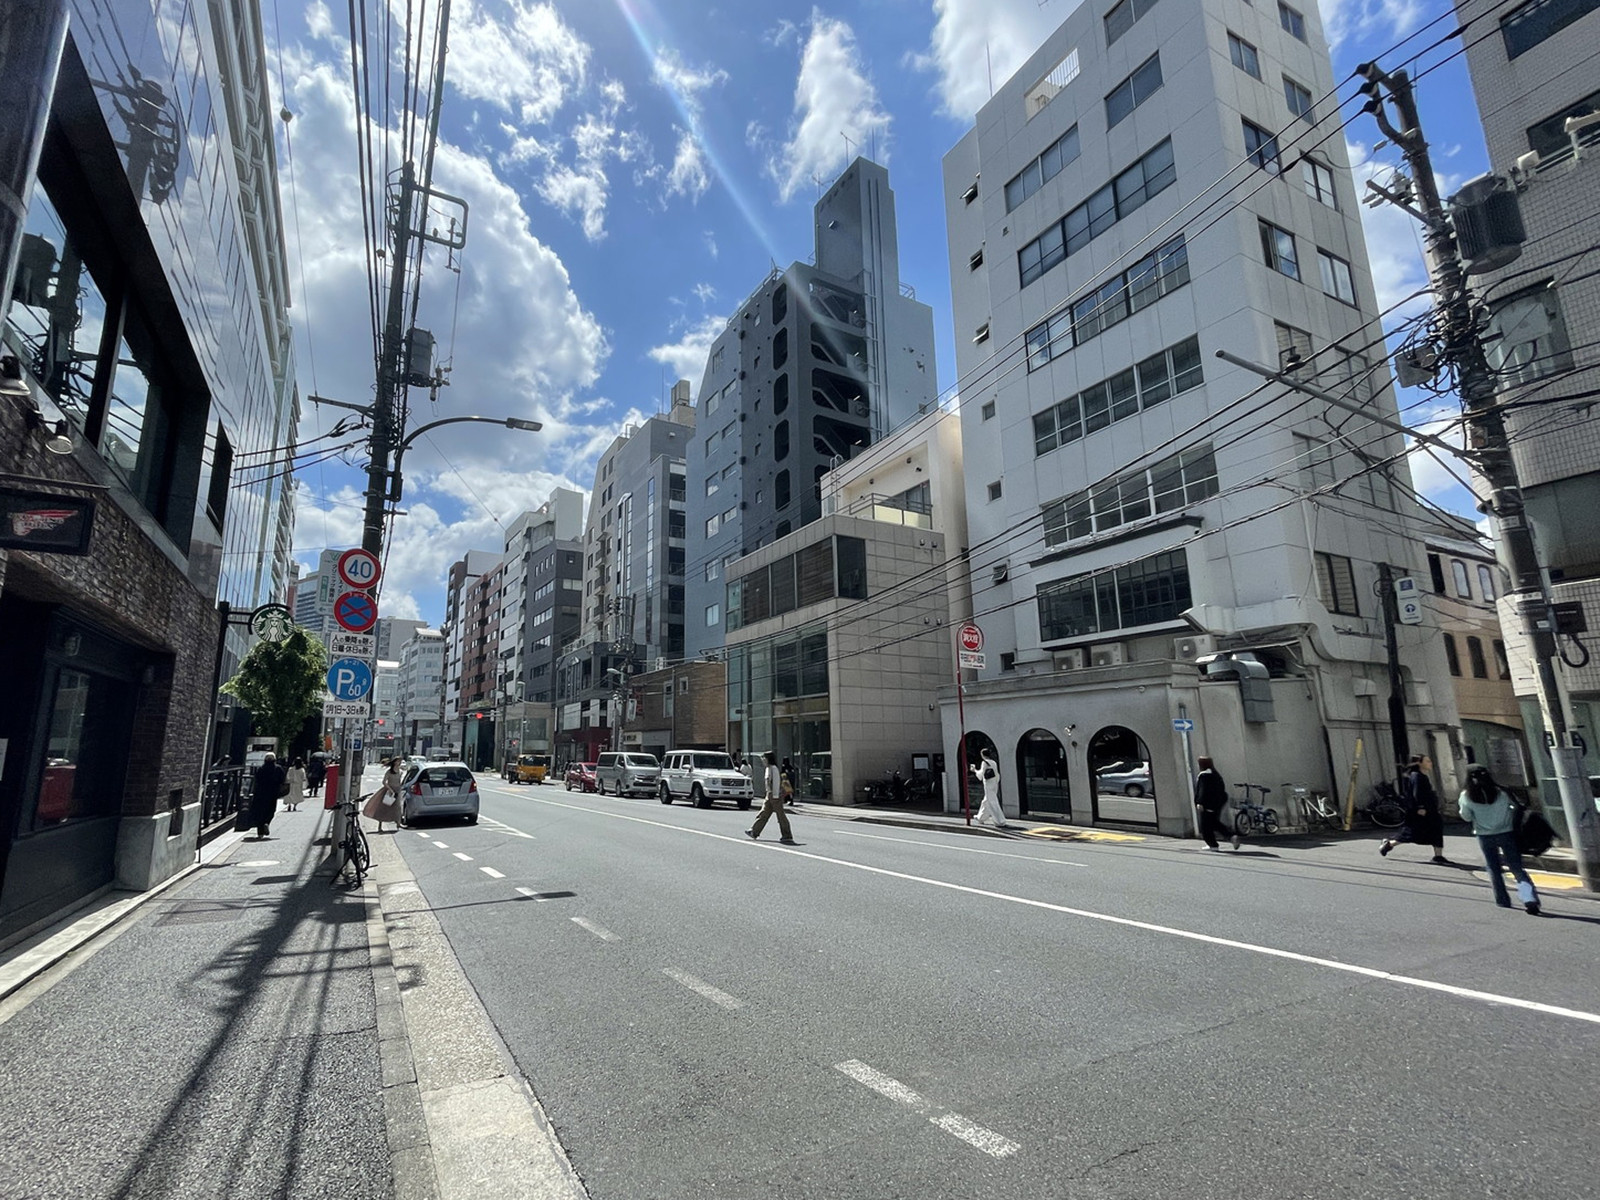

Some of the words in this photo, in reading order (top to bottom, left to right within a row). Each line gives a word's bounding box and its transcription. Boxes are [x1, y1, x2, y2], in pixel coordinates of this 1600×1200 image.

[348, 559, 372, 578] 40
[336, 668, 355, 695] P
[348, 684, 362, 697] 60
